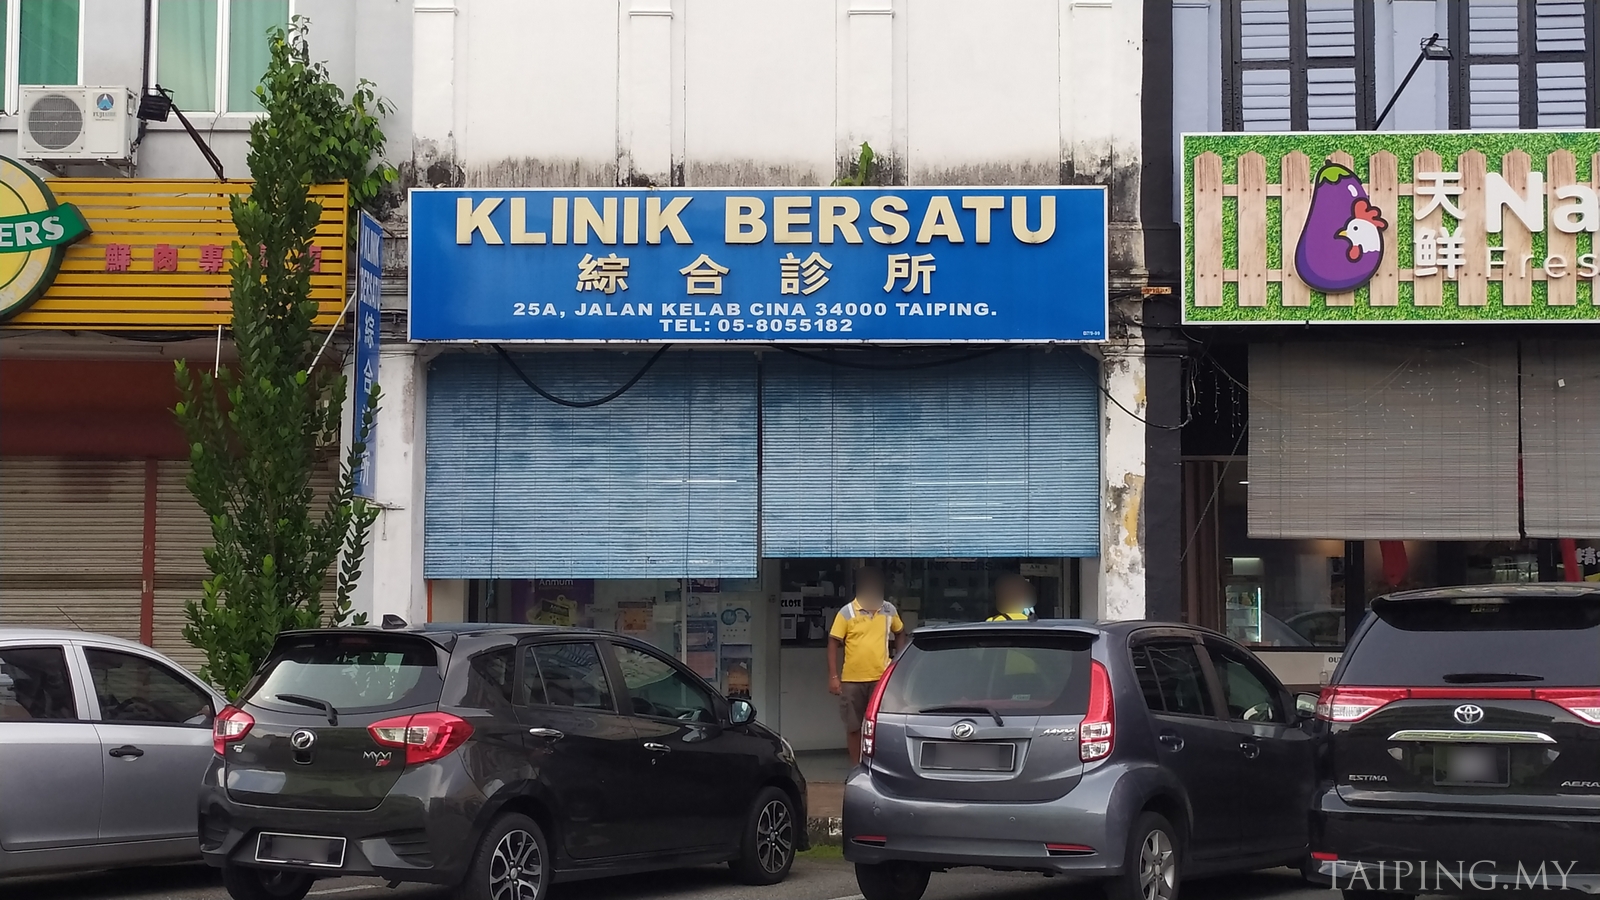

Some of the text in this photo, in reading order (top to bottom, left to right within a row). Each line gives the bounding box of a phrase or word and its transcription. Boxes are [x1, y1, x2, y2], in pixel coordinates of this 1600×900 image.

[456, 195, 1057, 245] KLINIK BERSATU
[575, 252, 937, 296] 綜合診所
[1486, 246, 1600, 278] Fres
[513, 302, 998, 319] 25A, JALAN KELAB CINA 34000 TAIPING.
[659, 318, 853, 332] TEL: 05-8055182
[1348, 774, 1388, 782] ESTIMA
